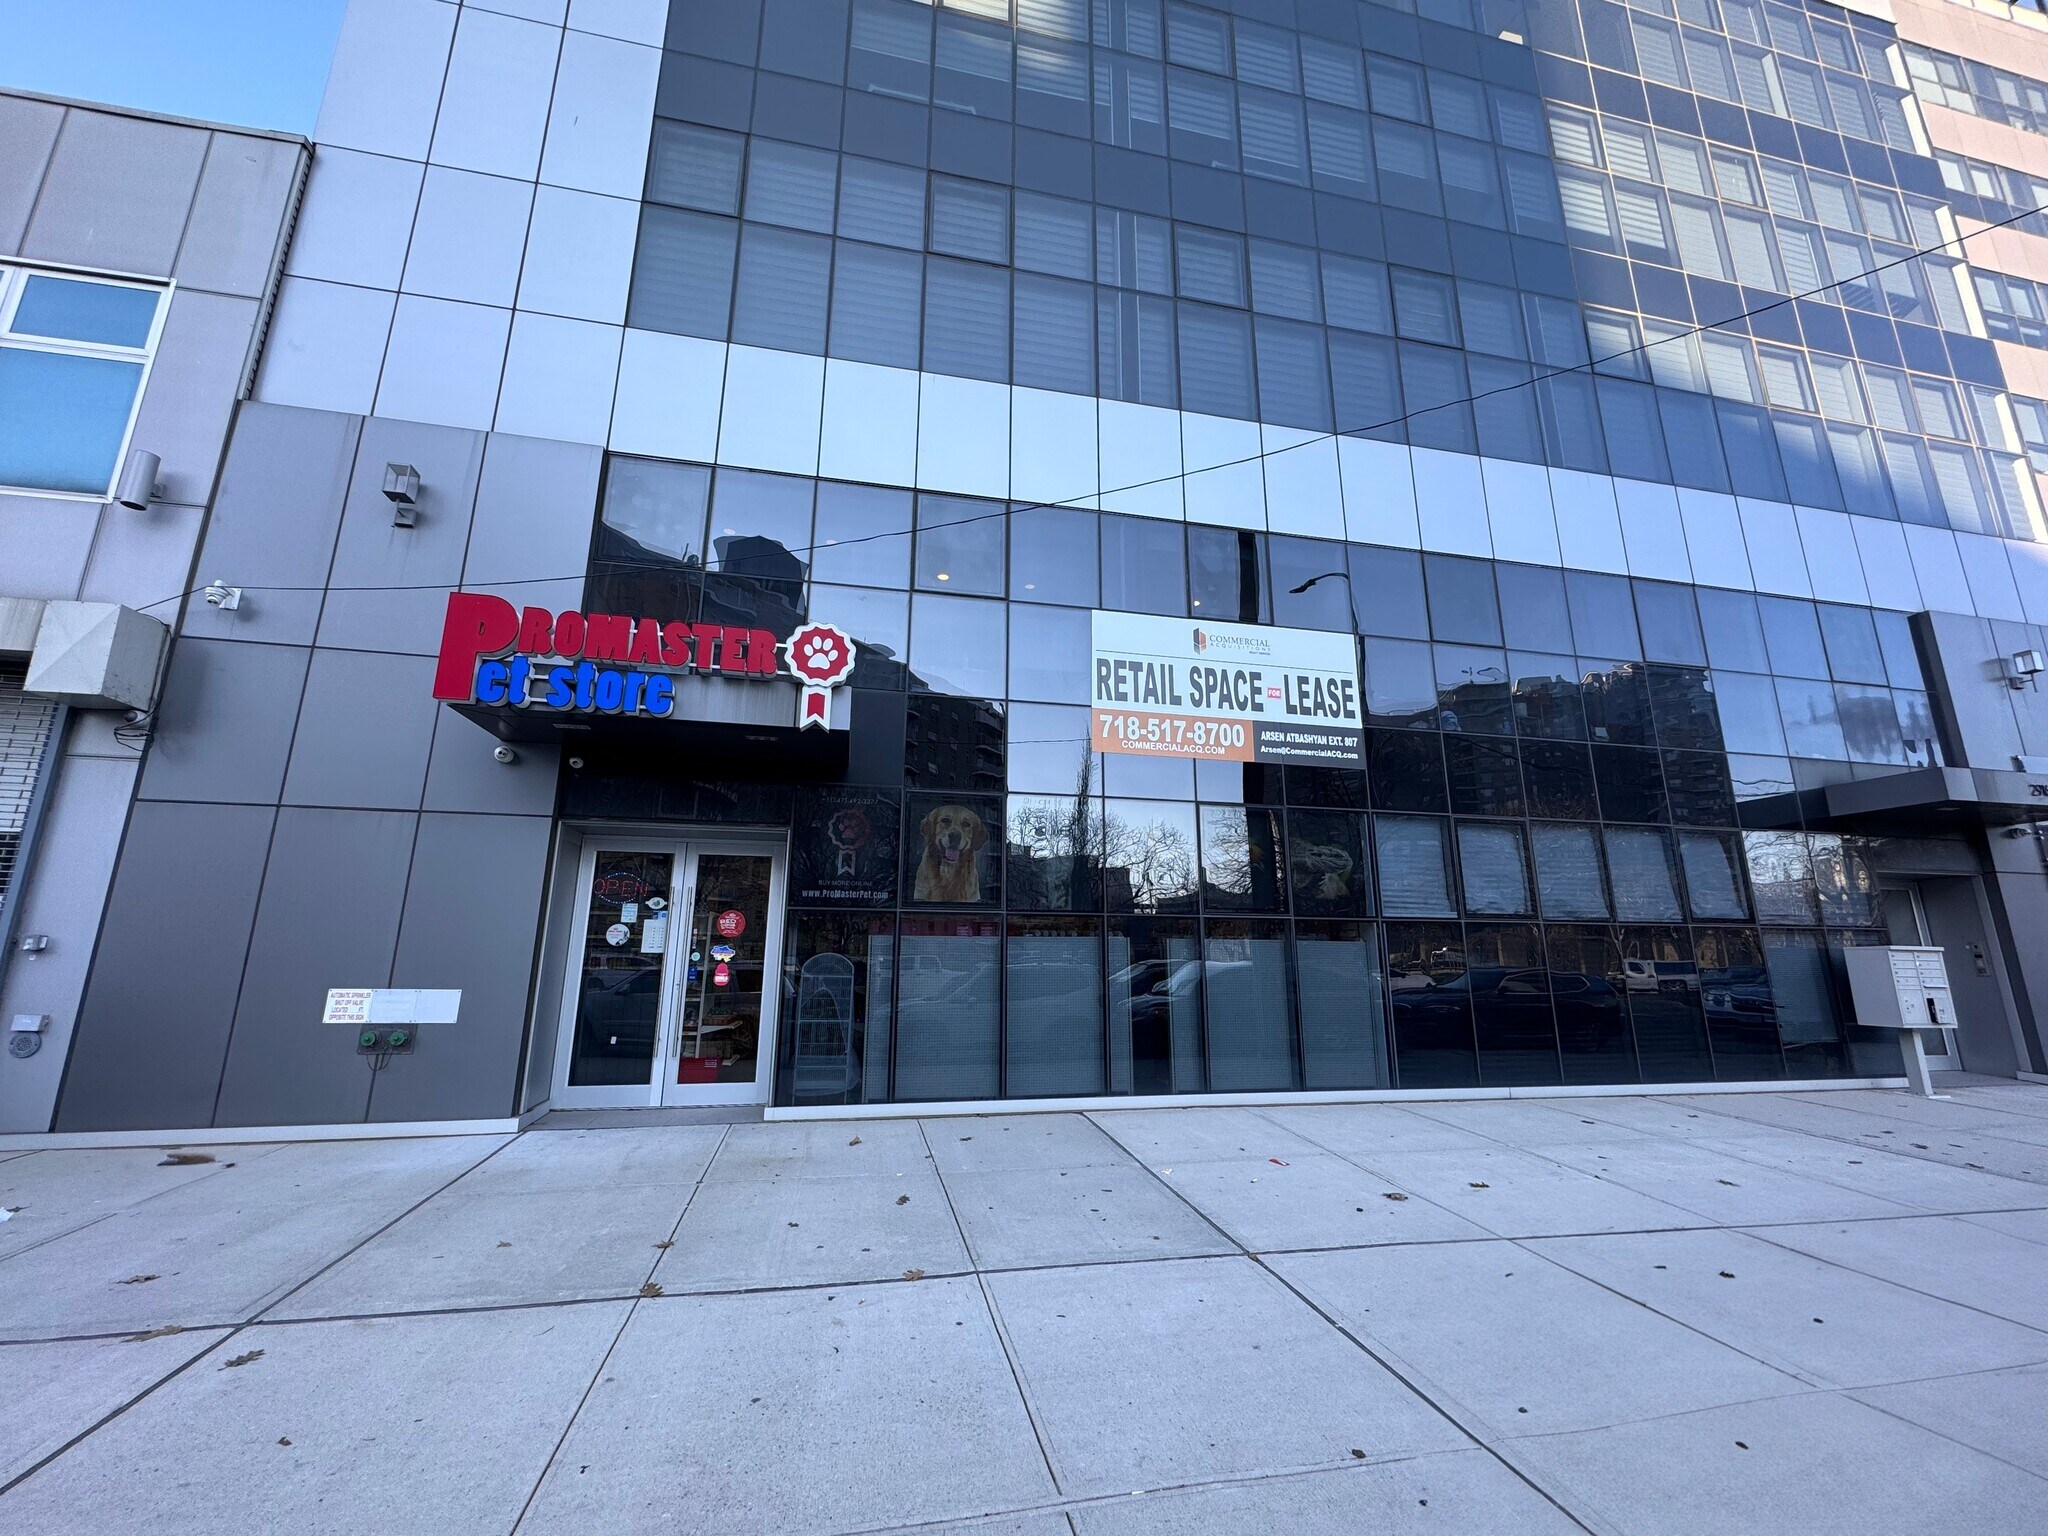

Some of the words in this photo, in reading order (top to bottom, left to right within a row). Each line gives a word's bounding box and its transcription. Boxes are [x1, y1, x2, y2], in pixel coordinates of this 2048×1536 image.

[433, 592, 778, 701] PROMASTER
[1209, 634, 1271, 647] COMMERCIAL
[1210, 642, 1271, 652] ACQUISITIONS
[546, 662, 675, 716] store
[1096, 658, 1182, 706] RETAIL
[1189, 665, 1265, 712] SPACE
[1268, 688, 1281, 698] FOR
[1283, 674, 1356, 720] LEASE
[1100, 714, 1245, 748] 718-517-8700
[1261, 731, 1285, 742] ARSEN
[1286, 732, 1328, 745] ATBASHYAN
[1328, 735, 1344, 747] EXT.
[1344, 737, 1358, 748] 807
[1122, 740, 1226, 755] COMMERCIALACQ.COM
[1260, 745, 1359, 759] Arsen@CommercialACQ.com
[594, 878, 650, 897] OPEN
[801, 889, 890, 899] www.ProMasterPet.com
